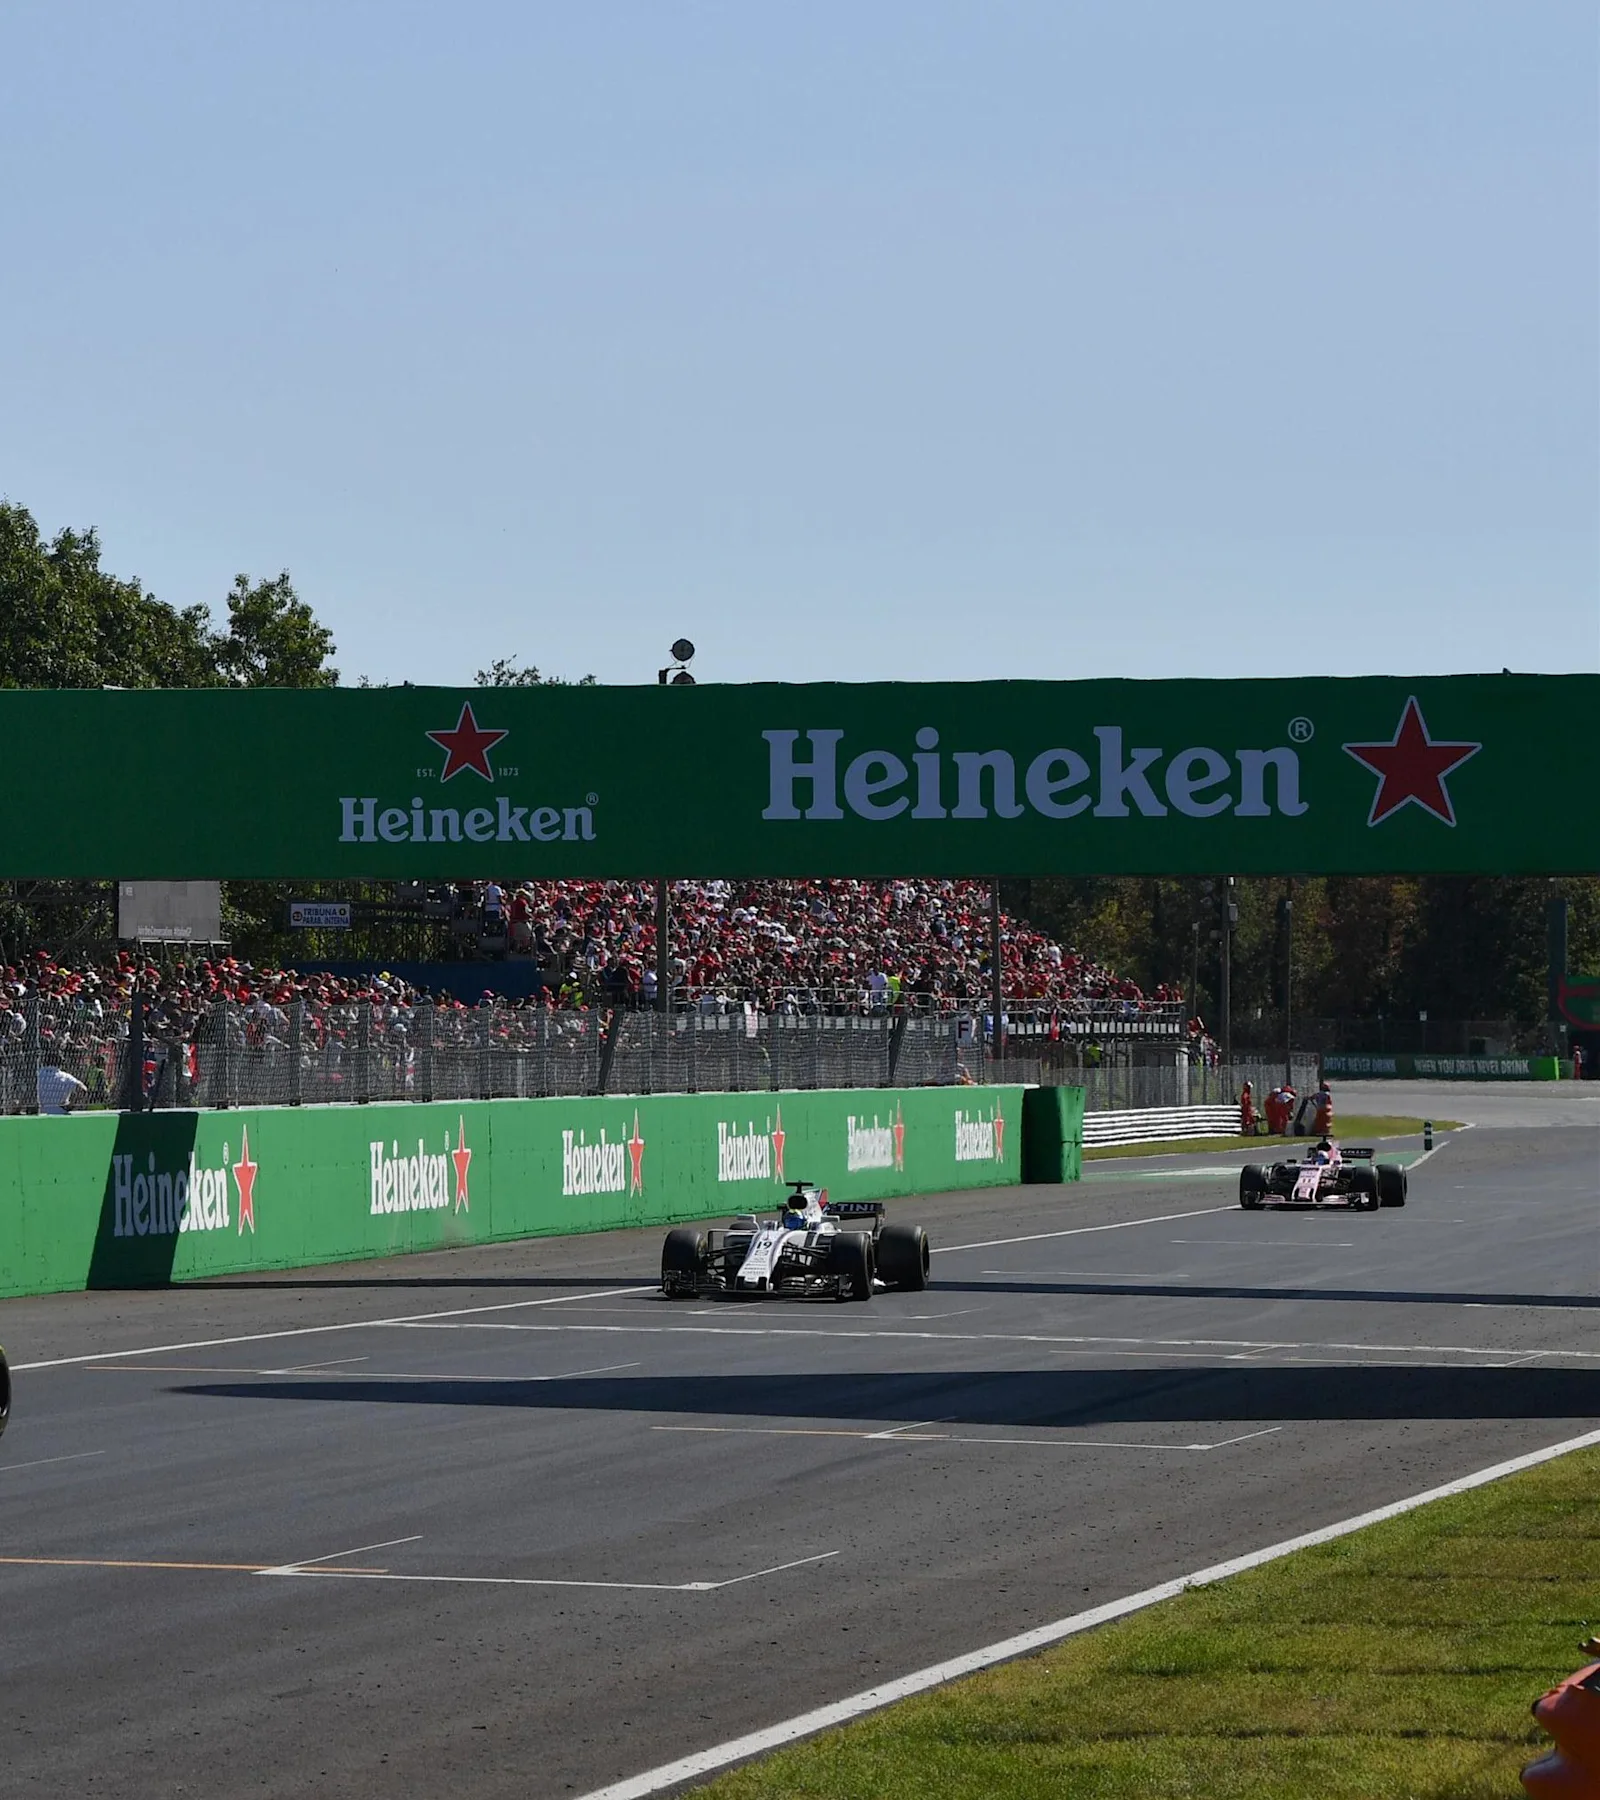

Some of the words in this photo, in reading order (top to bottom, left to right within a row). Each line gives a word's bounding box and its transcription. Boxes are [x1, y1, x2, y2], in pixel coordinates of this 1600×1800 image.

[416, 768, 436, 778] EST.
[498, 767, 519, 777] 1873
[761, 725, 1309, 820] Heineken
[338, 796, 597, 843] Heineken
[303, 908, 337, 916] TRIBUNA
[958, 1020, 969, 1039] F
[1437, 1060, 1455, 1073] YOU
[1500, 1060, 1529, 1074] DRINK
[717, 1120, 771, 1182] Heineken
[955, 1110, 994, 1161] Heineken
[369, 1138, 449, 1215] Heineken
[562, 1128, 626, 1196] Heineken
[113, 1151, 230, 1237] Heineken
[756, 1241, 773, 1249] 19
